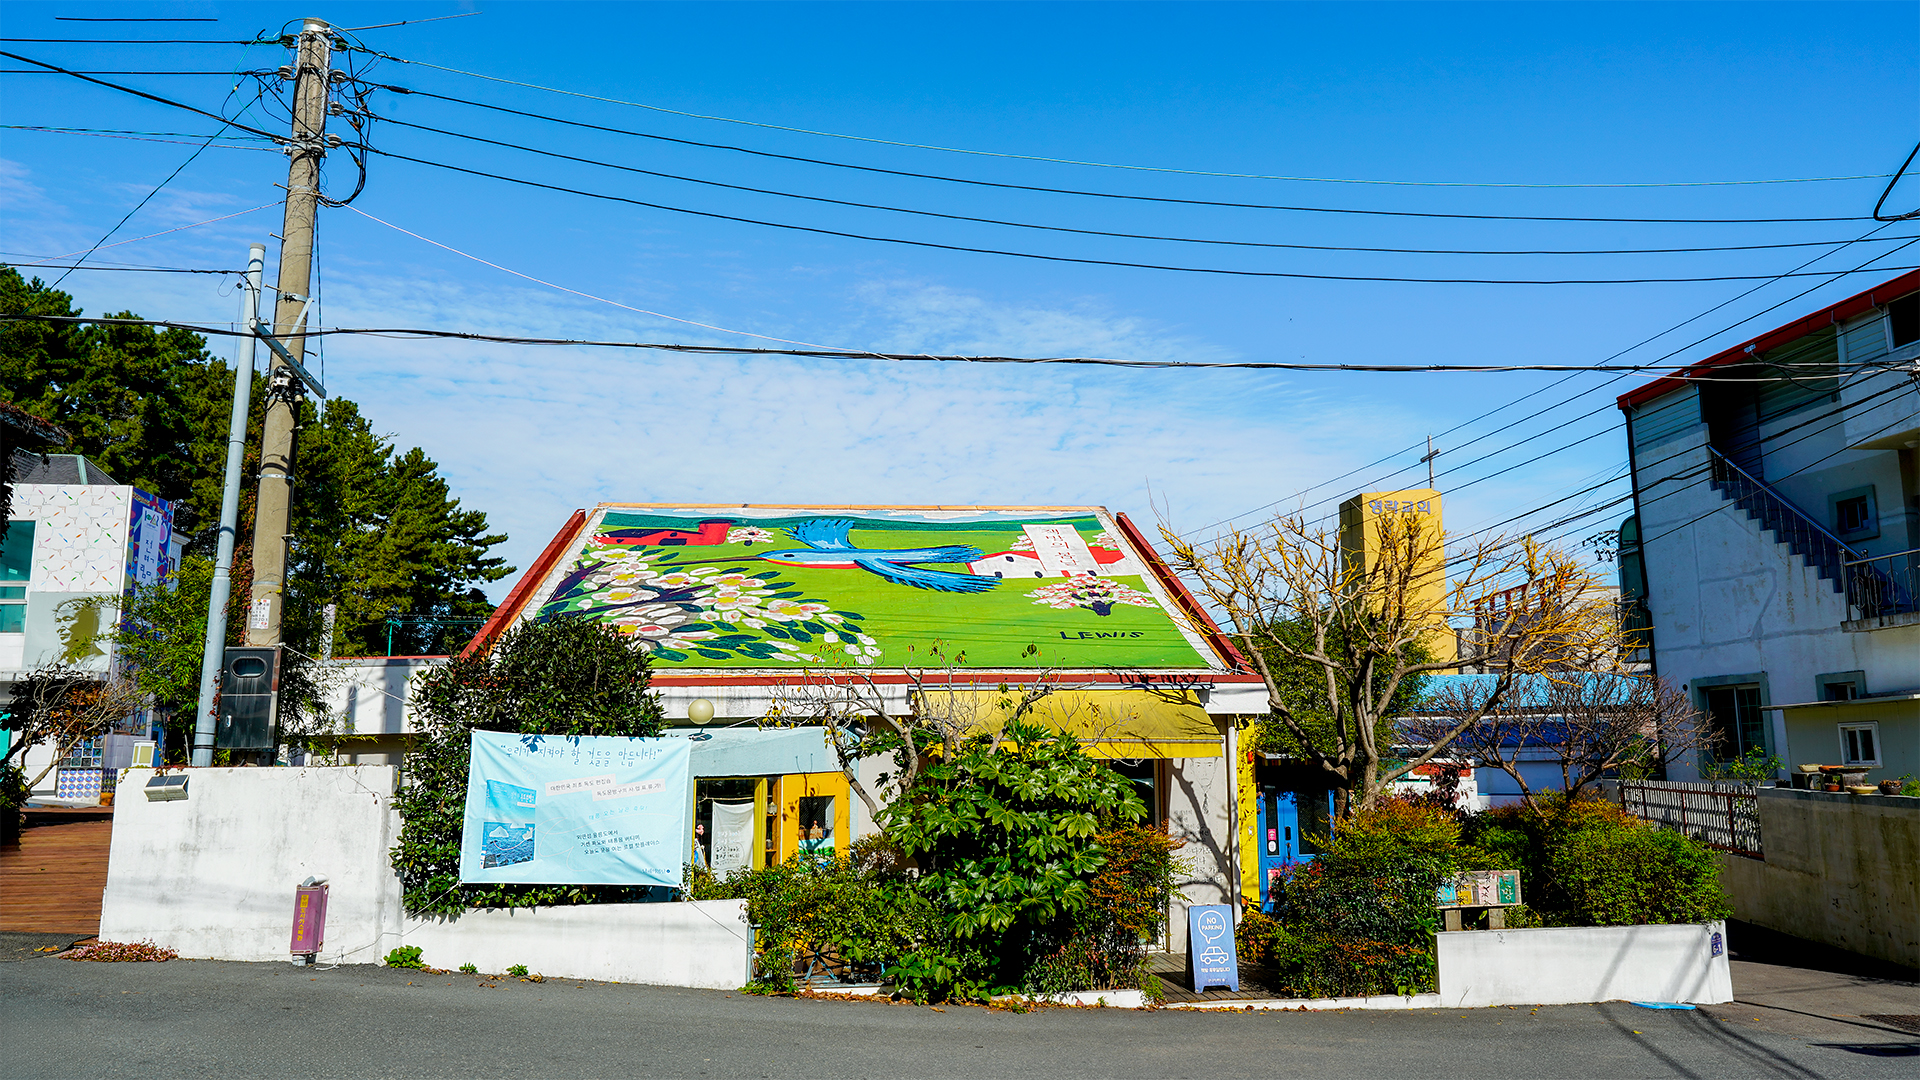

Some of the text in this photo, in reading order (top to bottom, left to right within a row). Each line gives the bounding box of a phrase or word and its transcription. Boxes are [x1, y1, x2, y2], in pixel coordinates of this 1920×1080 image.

[1060, 631, 1144, 640] LEWIS
[571, 747, 581, 765] 할
[587, 747, 611, 767] 것들을
[550, 783, 571, 791] 대한민국
